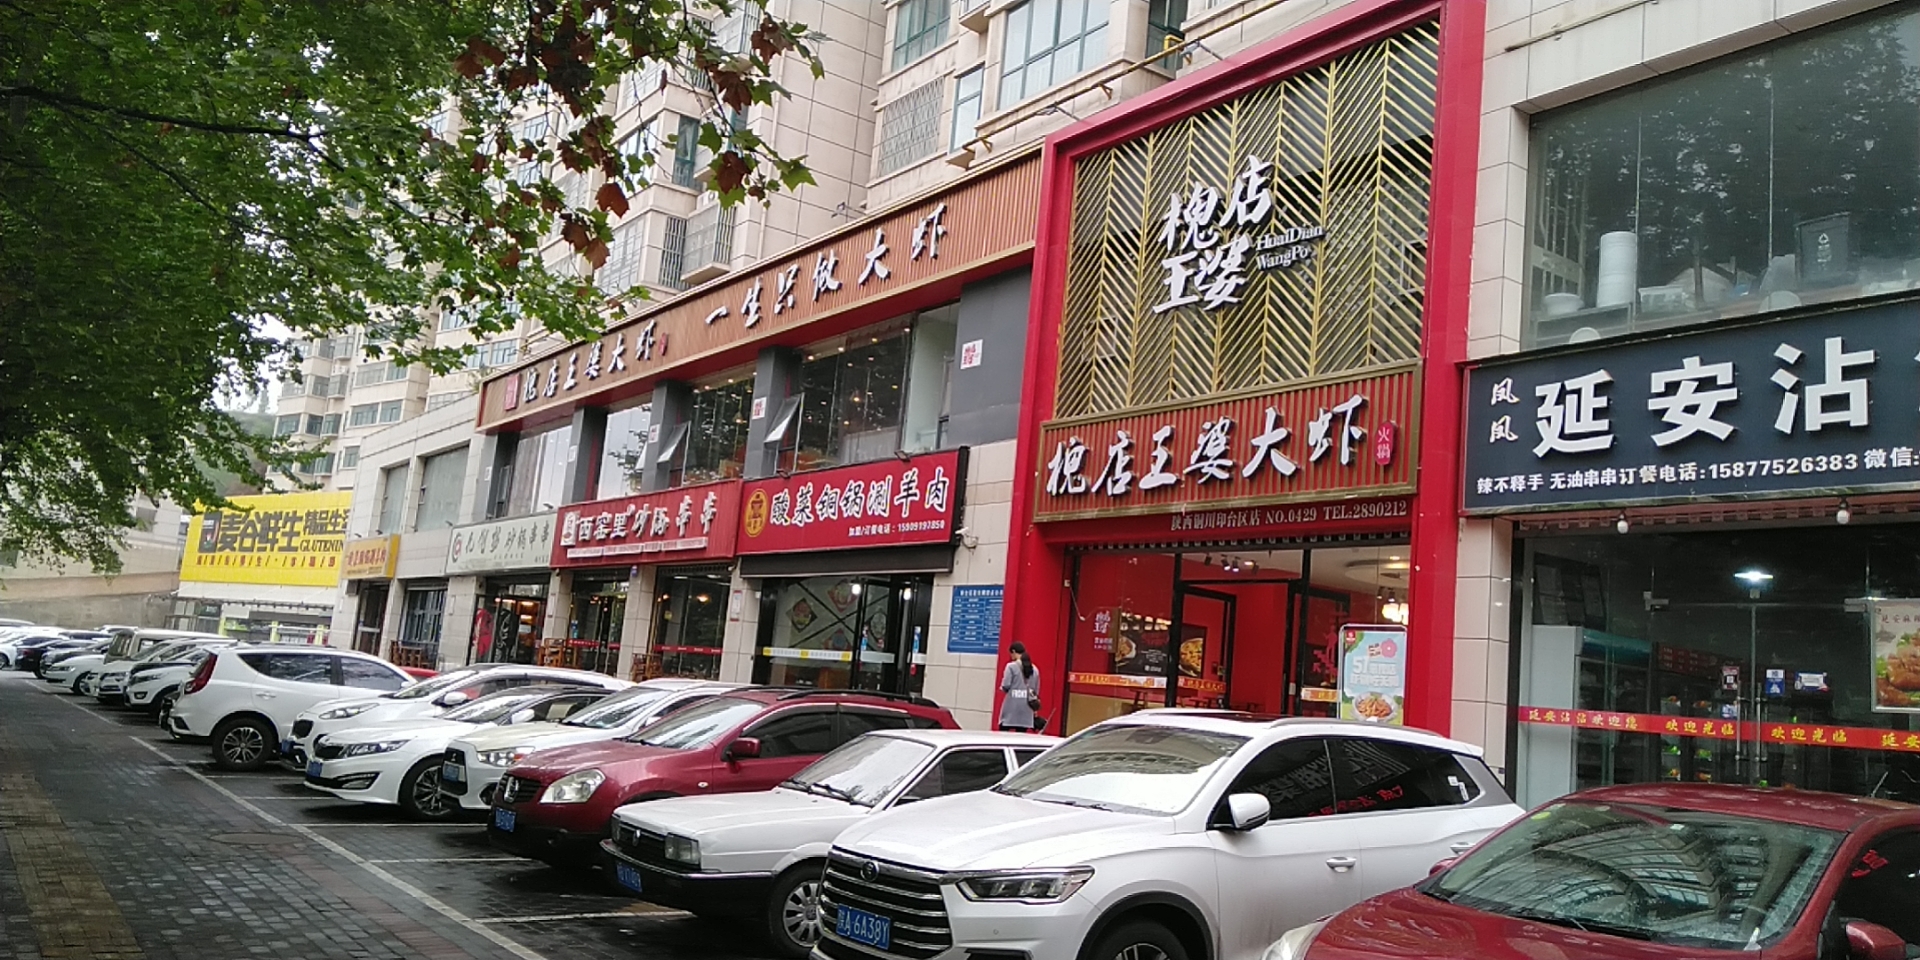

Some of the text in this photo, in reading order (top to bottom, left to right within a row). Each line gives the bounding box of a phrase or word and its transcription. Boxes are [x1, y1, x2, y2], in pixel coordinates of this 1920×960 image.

[705, 203, 948, 328] 一生只做大虾
[1533, 337, 1920, 458] 延安沾
[1046, 394, 1370, 497] 槐店王婆大虾
[1476, 474, 1544, 495] 辣不释手
[1864, 446, 1920, 469] 微信:
[770, 466, 949, 527] 酸菜铜锅涮羊肉
[1265, 507, 1318, 525] NO.0429
[1323, 501, 1408, 521] TEL:2890212
[217, 510, 304, 553] 麦谷鲜生
[1665, 719, 1735, 736] 欢迎光临
[1771, 726, 1847, 743] 欢迎光临
